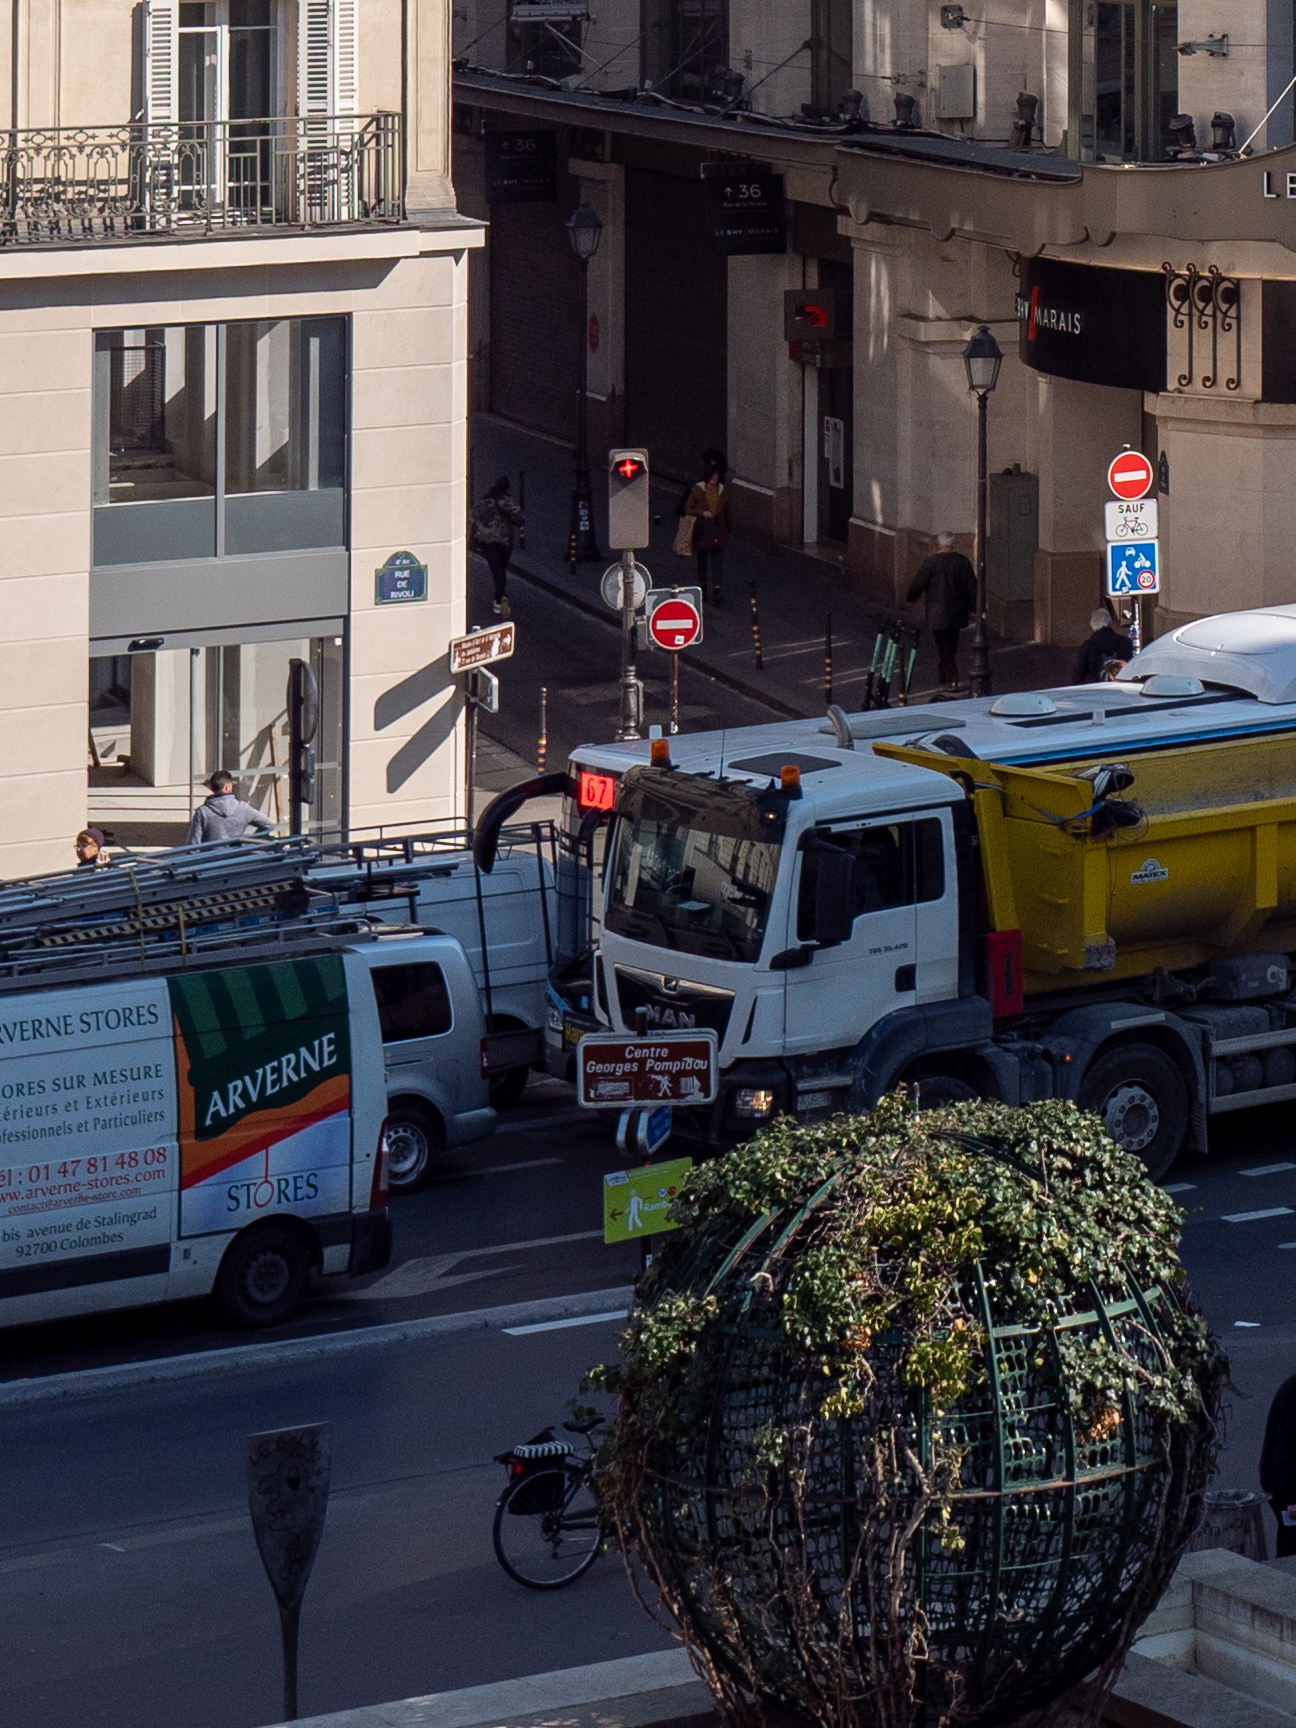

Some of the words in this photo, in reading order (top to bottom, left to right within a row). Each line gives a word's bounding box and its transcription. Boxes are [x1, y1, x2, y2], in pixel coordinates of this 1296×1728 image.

[739, 185, 761, 199] 36
[1118, 502, 1145, 514] SAUF
[394, 570, 410, 578] RUE
[396, 580, 408, 589] DE
[1141, 575, 1152, 585] 20
[390, 590, 415, 599] RIVOLI
[586, 778, 607, 807] 67
[1133, 869, 1168, 882] MATEX
[79, 1003, 160, 1034] STORES
[645, 1003, 697, 1029] MAN
[624, 1045, 669, 1060] Centre
[52, 1073, 87, 1093] SUR
[93, 1063, 164, 1088] MESURE
[204, 1031, 338, 1127] ARVERNE
[586, 1059, 639, 1076] Georges
[64, 1099, 80, 1115] et
[86, 1088, 165, 1111] Extérieurs
[77, 1117, 90, 1133] et
[93, 1108, 166, 1132] Particuliers
[28, 1164, 51, 1184] 01
[57, 1158, 82, 1180] 47
[86, 1155, 109, 1175] 81
[115, 1150, 140, 1171] 48
[143, 1145, 169, 1167] 08
[226, 1171, 319, 1212] STORES
[2, 1228, 21, 1243] bis
[26, 1220, 74, 1240] avenue
[75, 1216, 92, 1232] de
[94, 1205, 158, 1230] Stalingrad
[15, 1241, 59, 1259] 92700
[60, 1230, 125, 1254] Colombes
